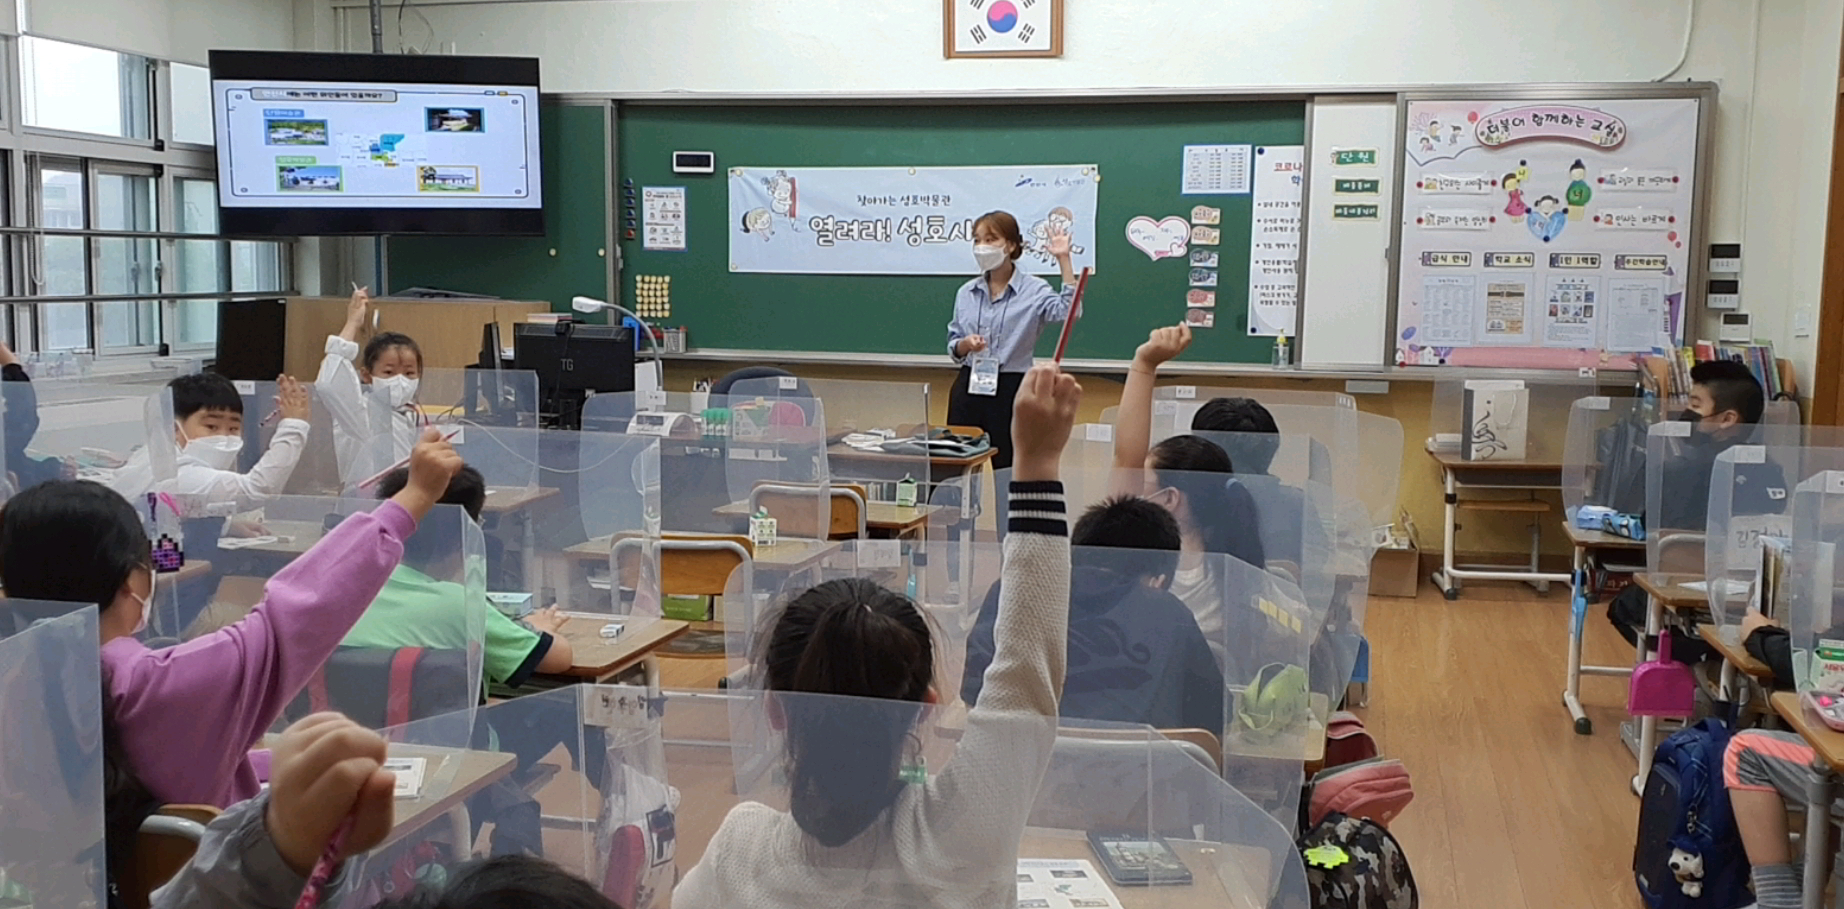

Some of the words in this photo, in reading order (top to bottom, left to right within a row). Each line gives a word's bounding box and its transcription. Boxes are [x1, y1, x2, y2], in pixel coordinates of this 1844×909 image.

[1486, 117, 1525, 134] 더불어
[1532, 112, 1585, 128] 함께하는
[1589, 119, 1617, 137] 교실
[1274, 162, 1303, 172] 코로나
[1572, 188, 1584, 199] 너
[856, 194, 897, 207] 찾아가는
[899, 194, 951, 207] 성호박물관
[1641, 214, 1667, 225] 바르게
[808, 214, 893, 247] 열려라!
[896, 214, 974, 247] 성호사
[1430, 254, 1448, 264] 급식
[1451, 254, 1468, 264] 안내
[1494, 255, 1511, 264] 학교
[1515, 255, 1532, 264] 소식
[561, 358, 574, 371] TG
